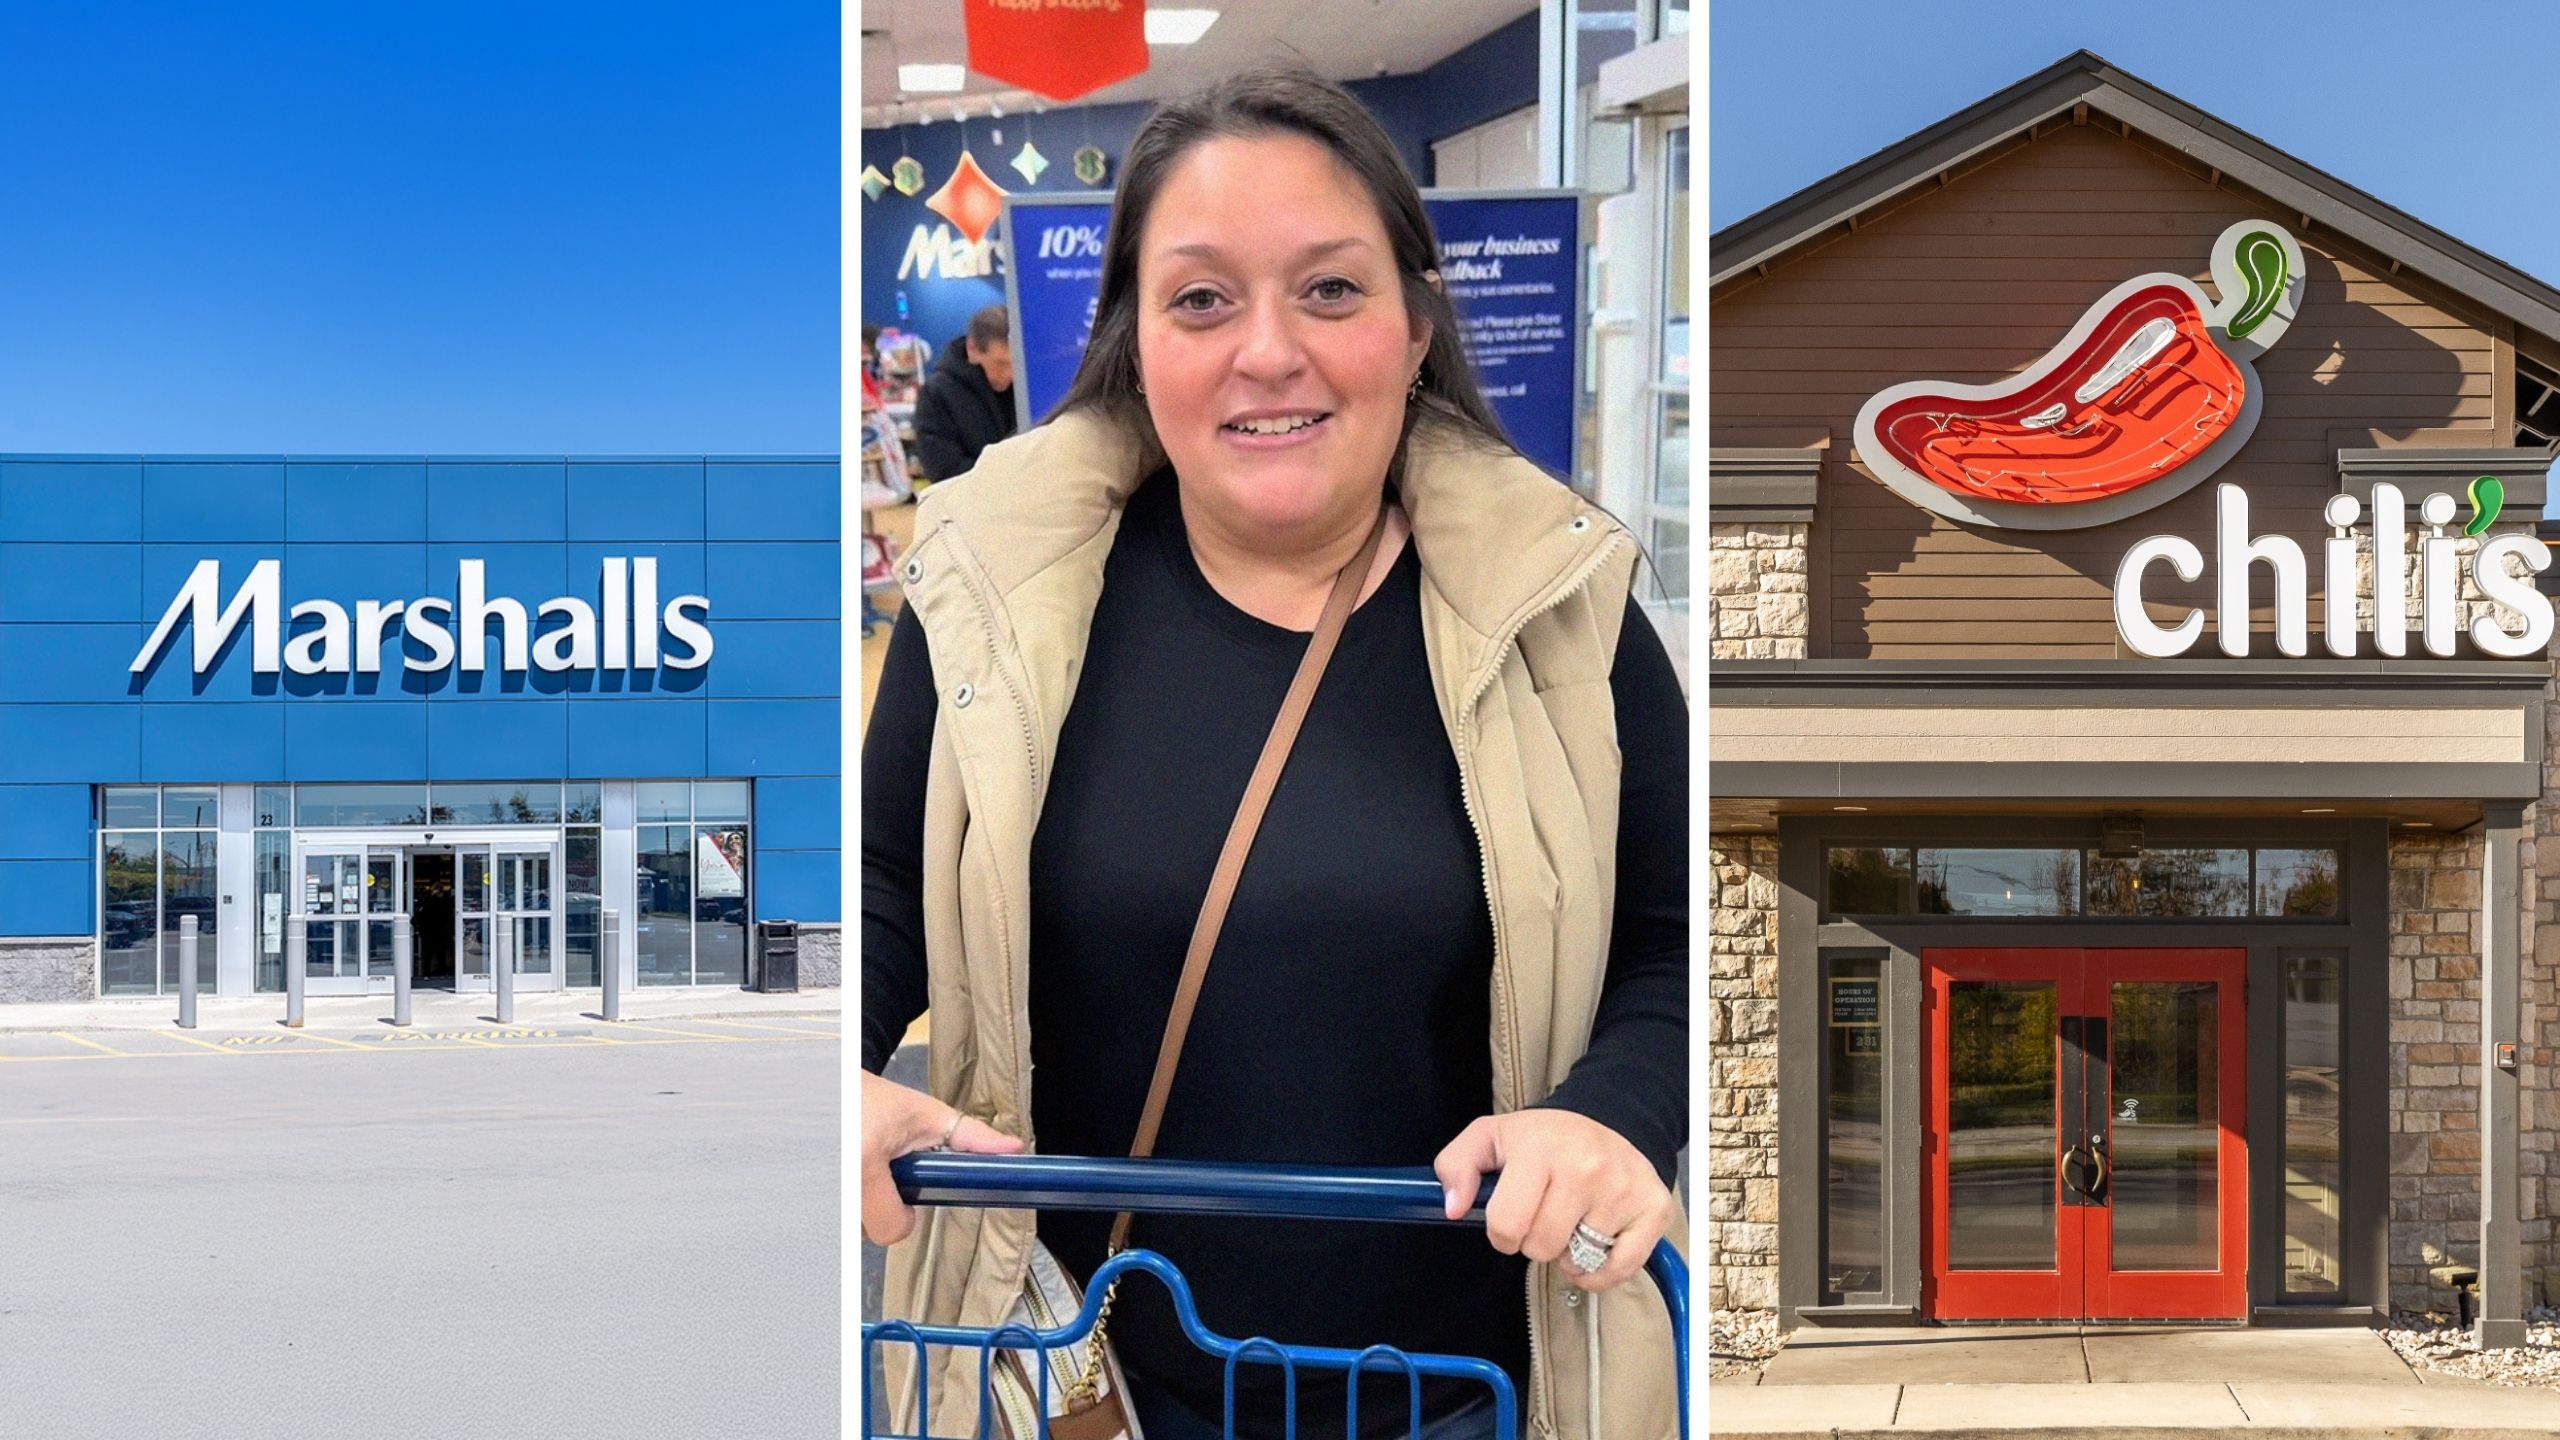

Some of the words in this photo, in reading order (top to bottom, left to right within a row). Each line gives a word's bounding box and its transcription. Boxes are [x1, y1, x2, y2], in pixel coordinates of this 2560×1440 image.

[1038, 225, 1103, 259] 10%
[1482, 233, 1562, 256] business
[2114, 476, 2556, 657] chili's
[128, 556, 714, 674] Marshalls
[261, 815, 273, 826] 23
[383, 1030, 559, 1041] PARKING
